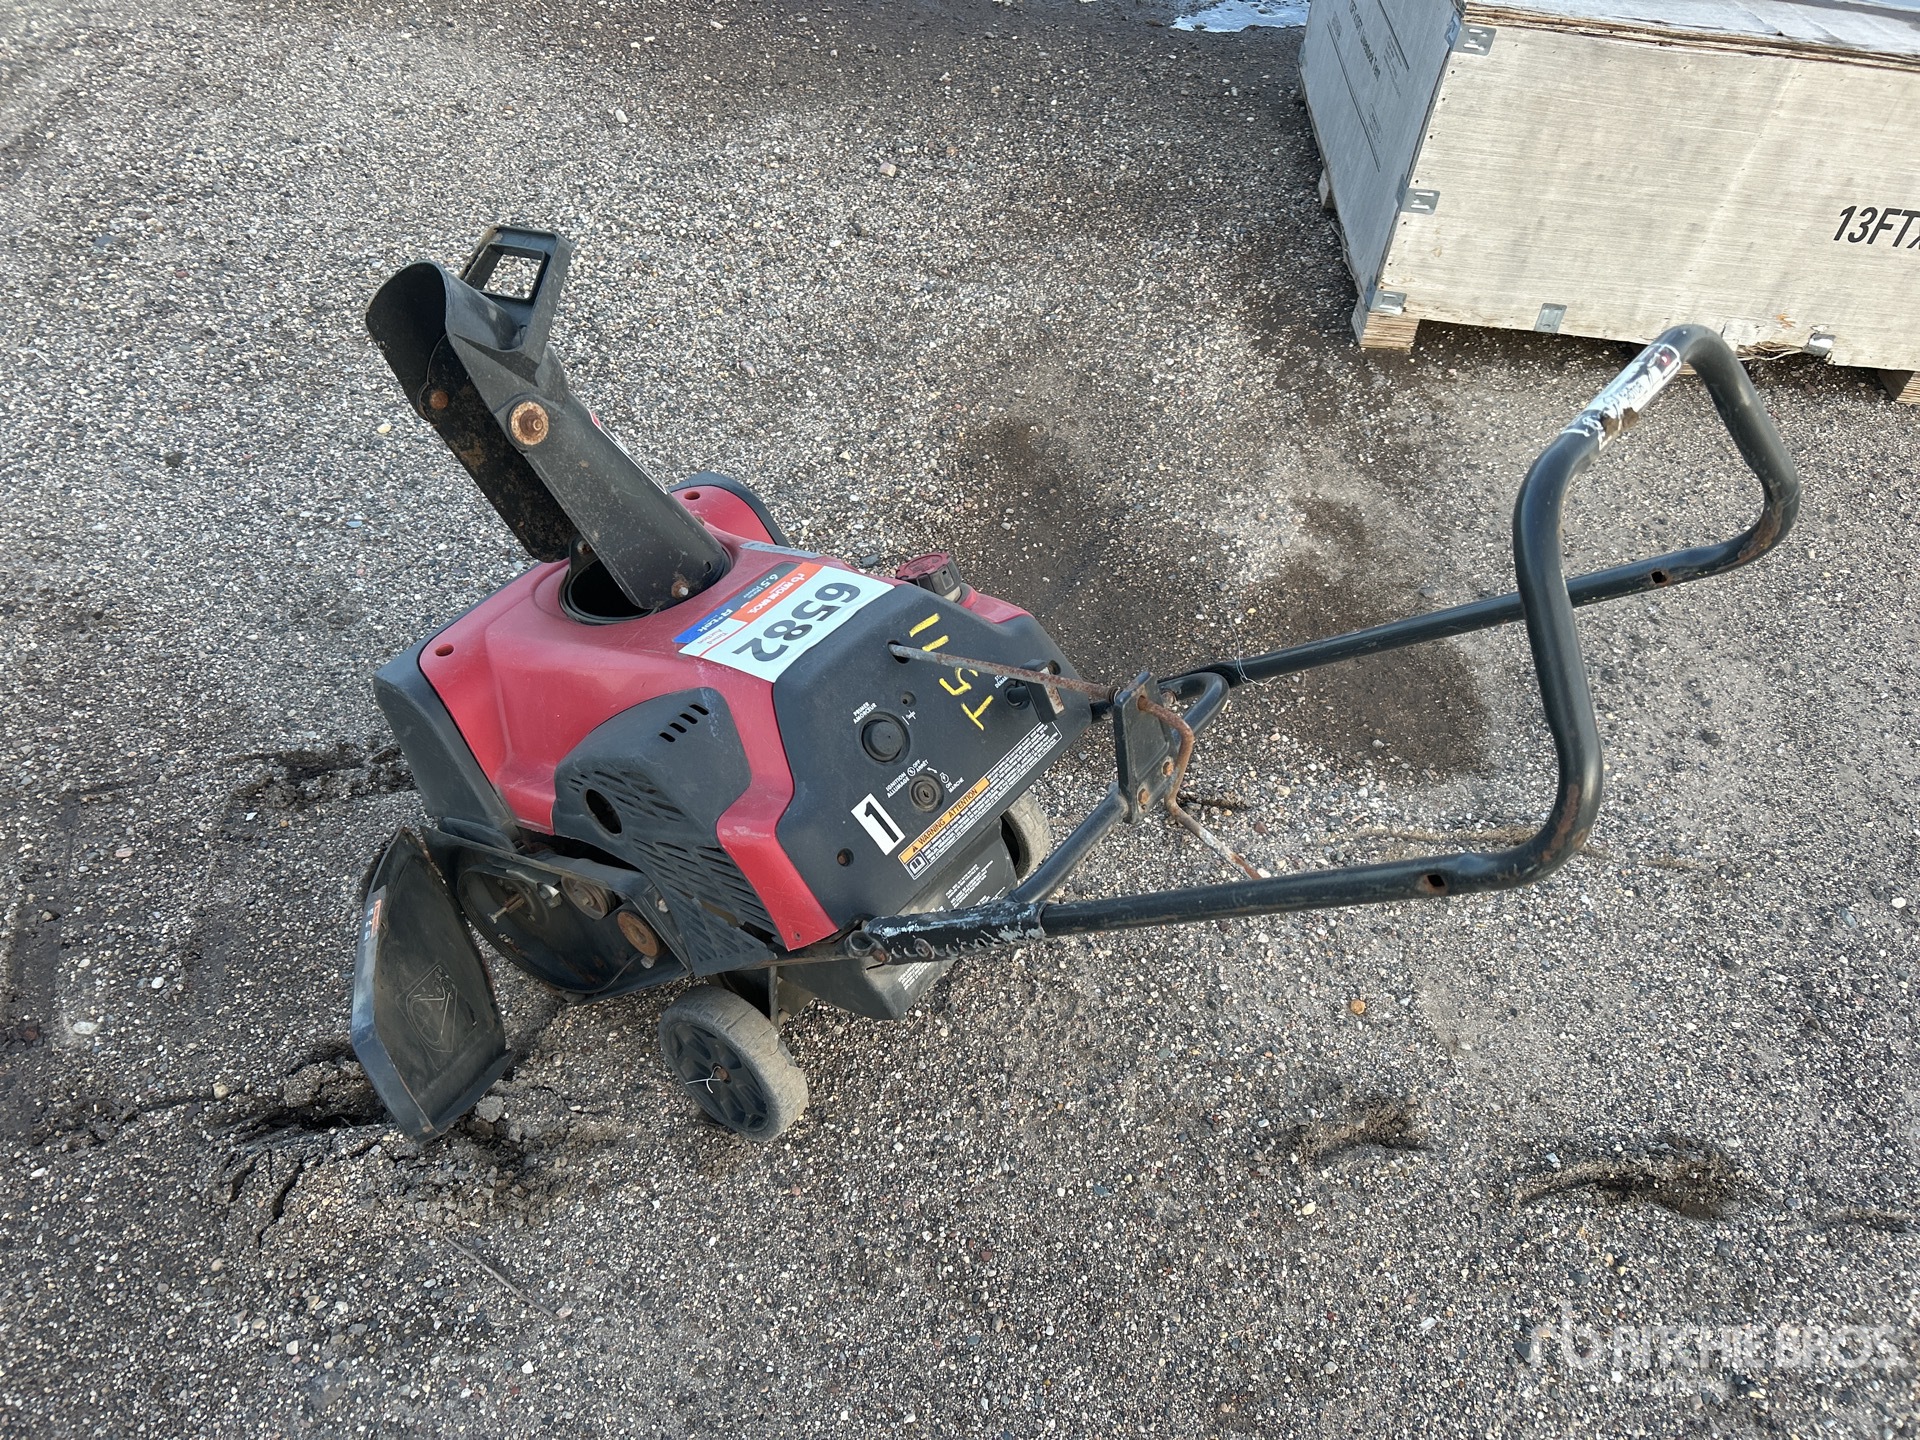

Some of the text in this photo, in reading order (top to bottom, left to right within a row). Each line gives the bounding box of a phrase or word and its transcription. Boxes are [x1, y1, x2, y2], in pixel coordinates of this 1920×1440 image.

[760, 573, 779, 588] 6.5
[731, 582, 861, 662] 6582
[852, 701, 870, 717] PRIMER
[852, 702, 877, 724] AMORCEUR
[885, 771, 907, 792] IGNITION
[886, 777, 911, 799] ALLUMAGE
[948, 776, 965, 794] MARCHE
[864, 802, 899, 844] 1
[918, 818, 946, 845] WARNING
[948, 788, 978, 819] ATTENTION
